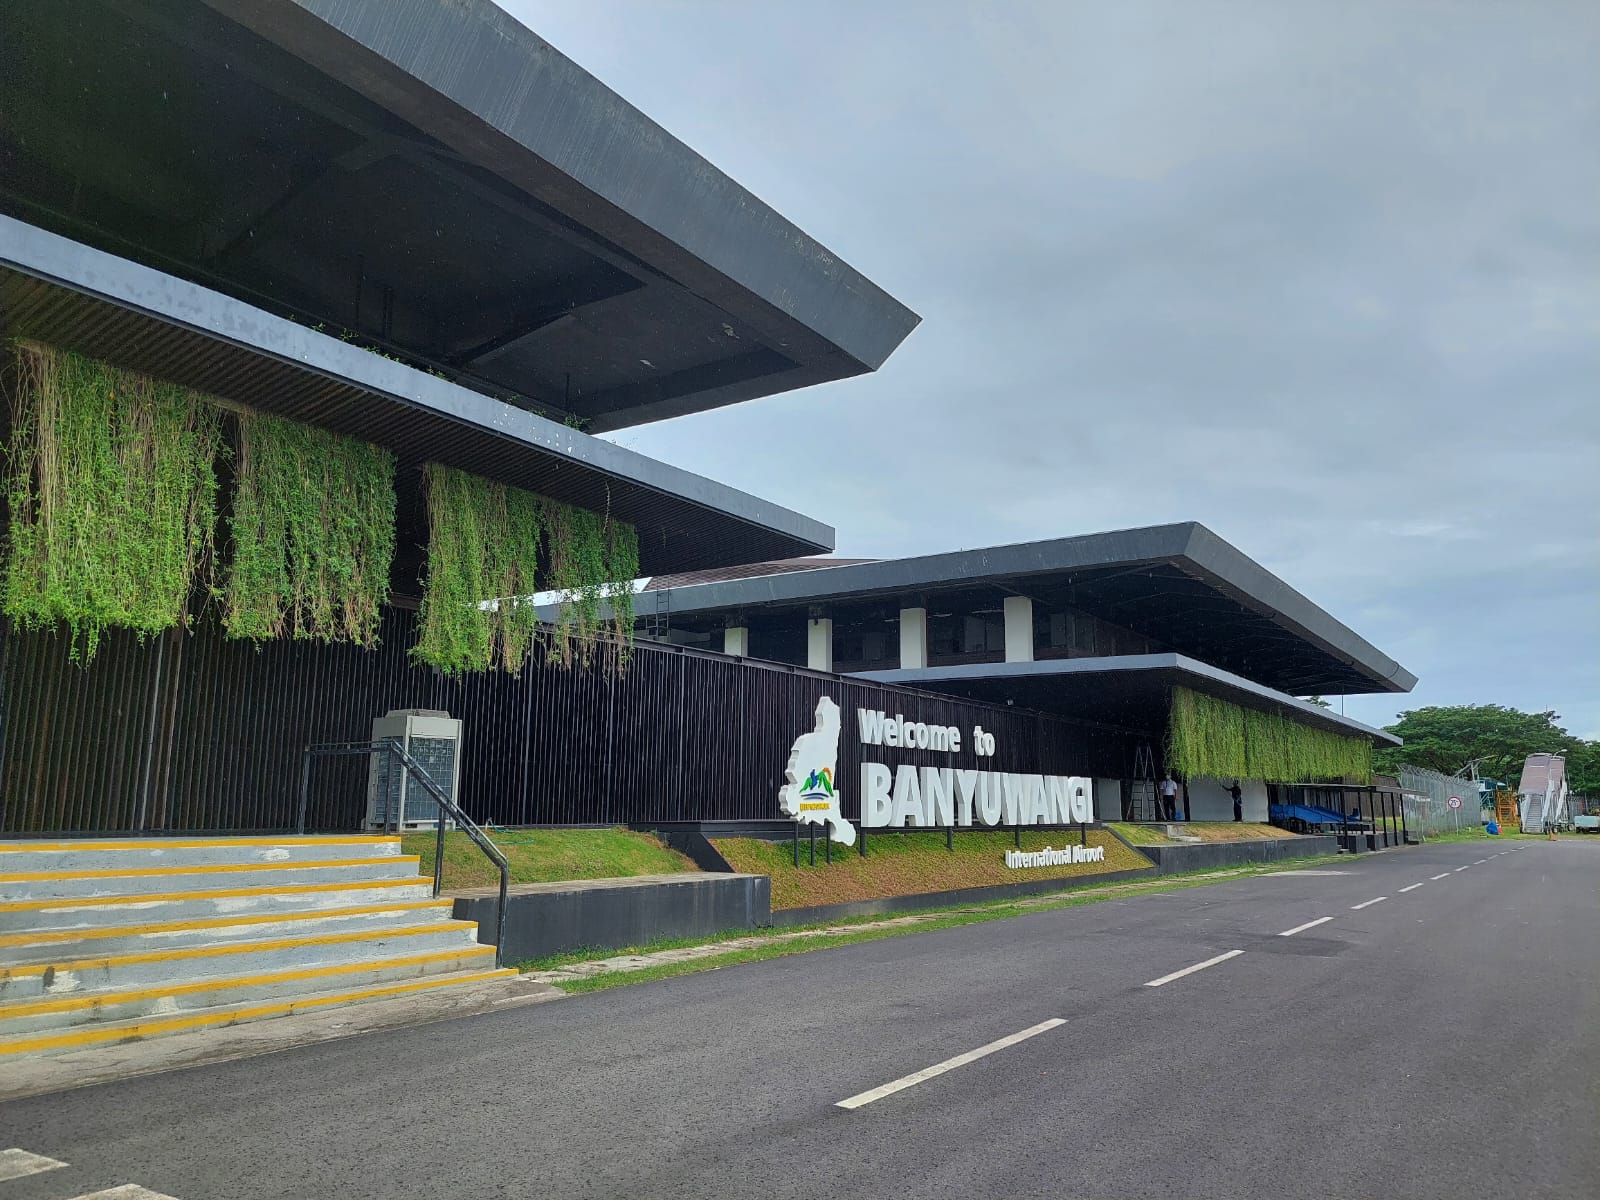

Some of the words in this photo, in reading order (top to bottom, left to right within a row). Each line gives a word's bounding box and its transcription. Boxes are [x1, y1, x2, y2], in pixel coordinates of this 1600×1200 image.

[857, 708, 961, 752] Welcome
[974, 725, 995, 756] to
[860, 762, 1094, 828] BANYUWANGI
[1004, 845, 1071, 869] International
[1072, 845, 1104, 864] Airport
